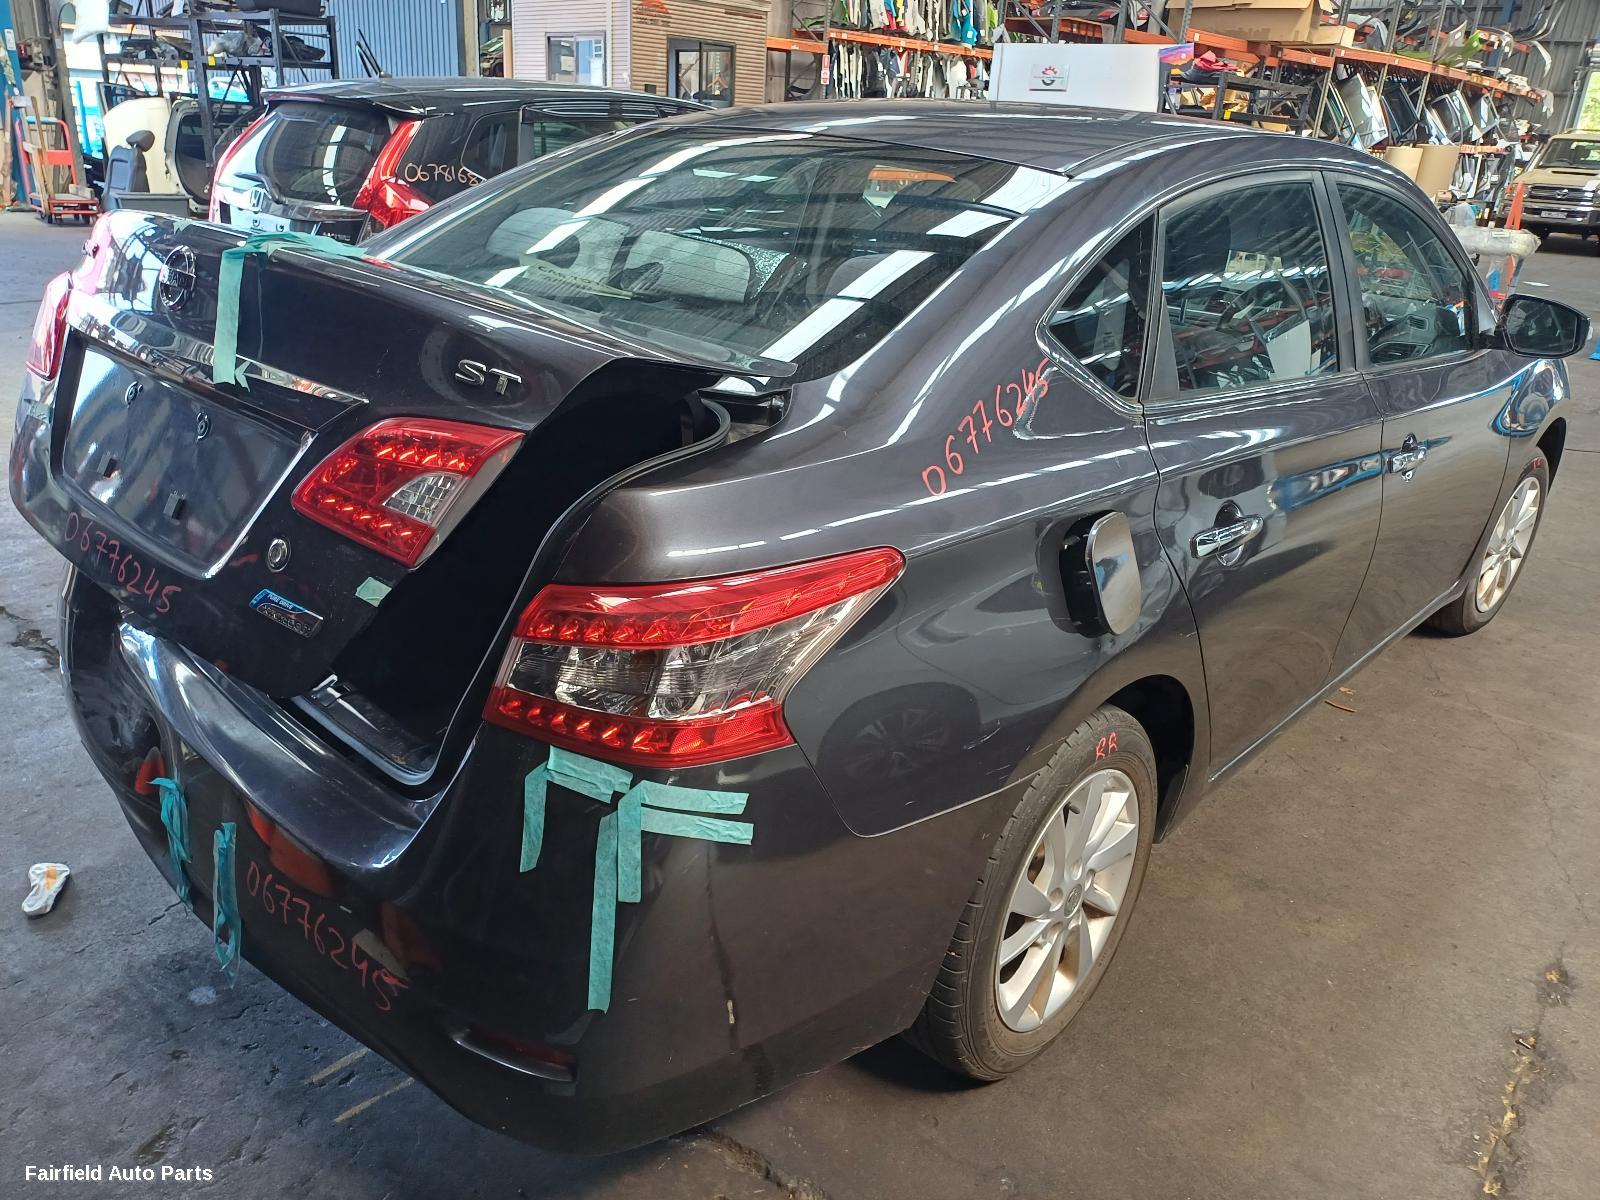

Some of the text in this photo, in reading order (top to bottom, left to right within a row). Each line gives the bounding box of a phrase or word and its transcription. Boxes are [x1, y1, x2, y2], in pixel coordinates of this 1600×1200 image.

[454, 359, 523, 396] ST
[64, 511, 183, 614] 06776245
[246, 860, 409, 1012] 06776245
